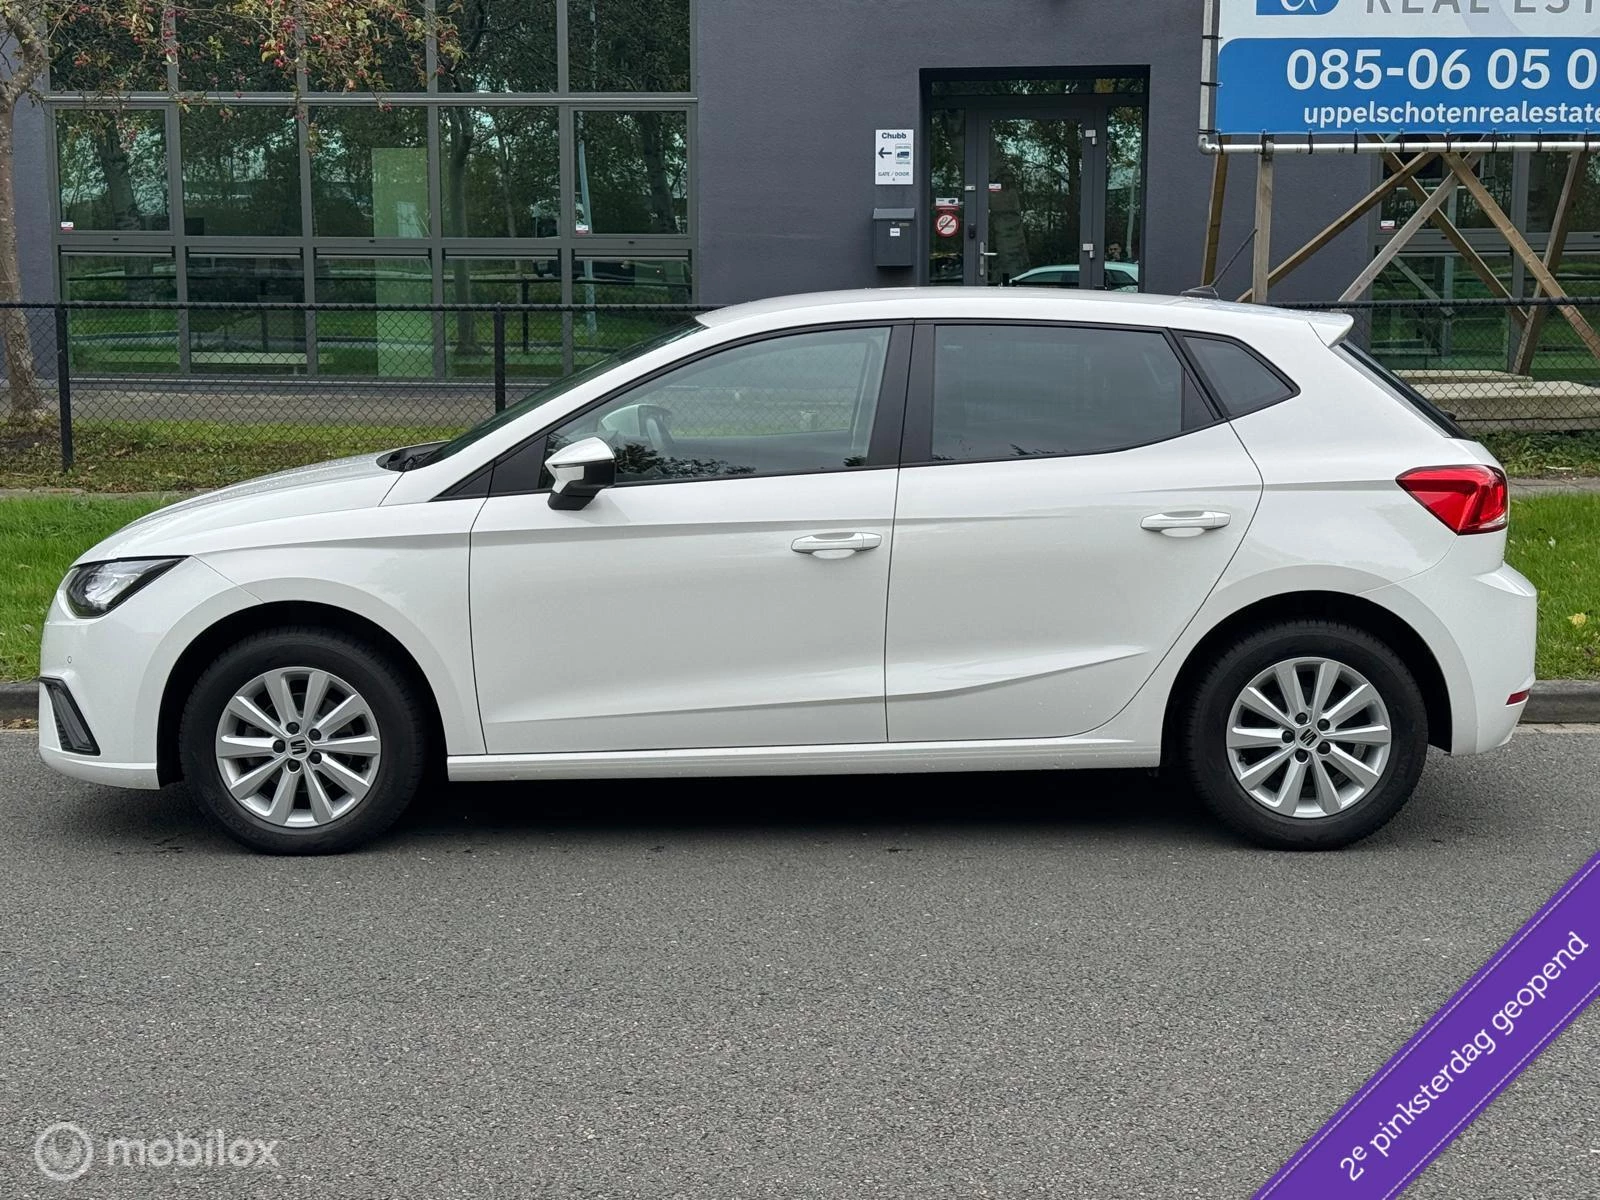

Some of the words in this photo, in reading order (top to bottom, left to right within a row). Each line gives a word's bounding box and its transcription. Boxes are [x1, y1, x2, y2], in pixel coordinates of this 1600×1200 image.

[1287, 48, 1472, 90] 085-06
[1487, 48, 1550, 90] 05
[1567, 48, 1598, 90] 0
[881, 132, 907, 140] Chubb
